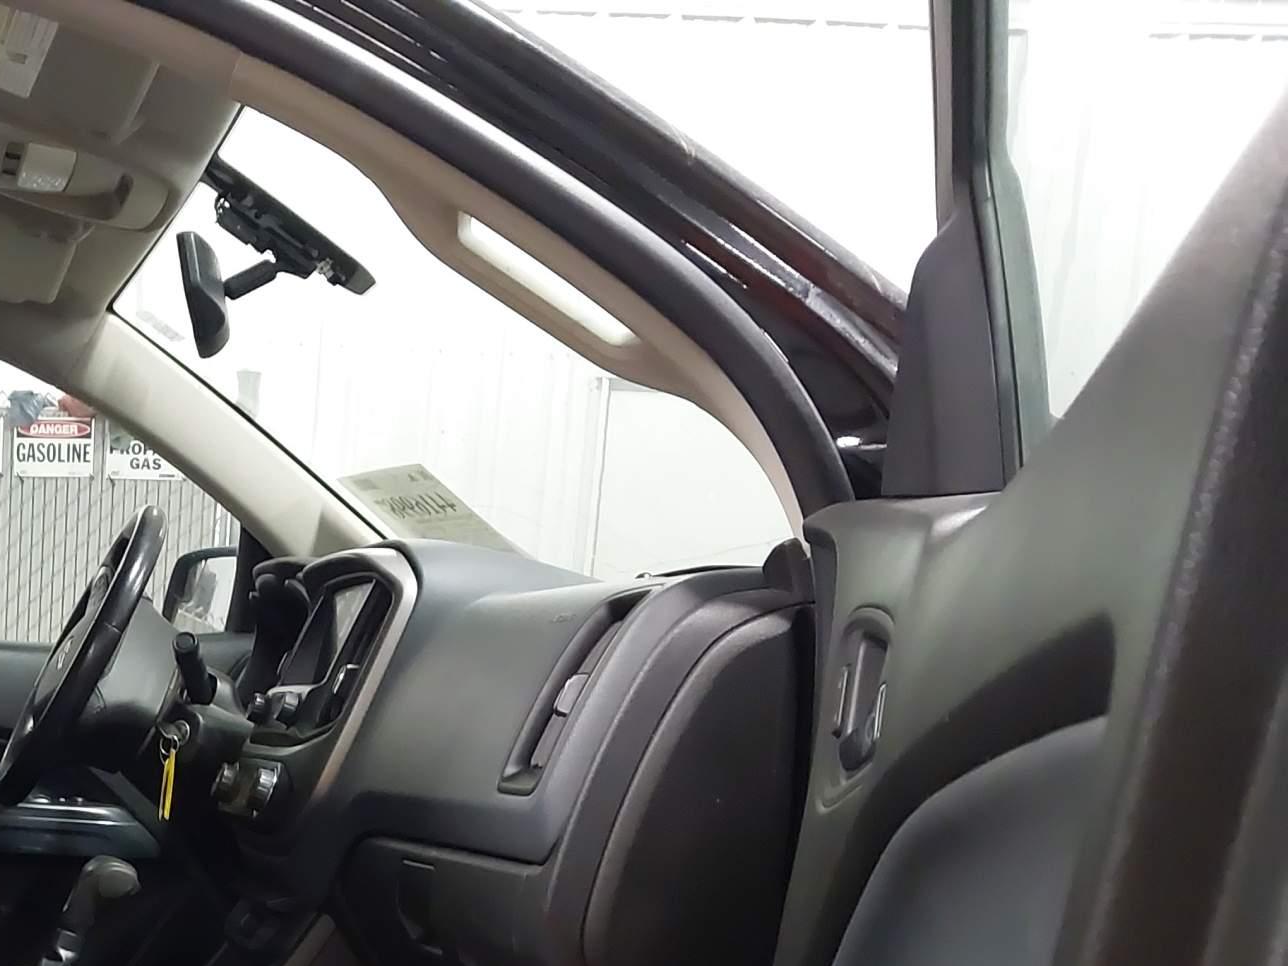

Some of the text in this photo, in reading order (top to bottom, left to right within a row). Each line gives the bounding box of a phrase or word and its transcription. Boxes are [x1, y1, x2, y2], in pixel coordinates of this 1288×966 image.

[29, 423, 79, 436] DANGER
[16, 442, 91, 463] GASOLINE
[130, 457, 162, 470] GAS
